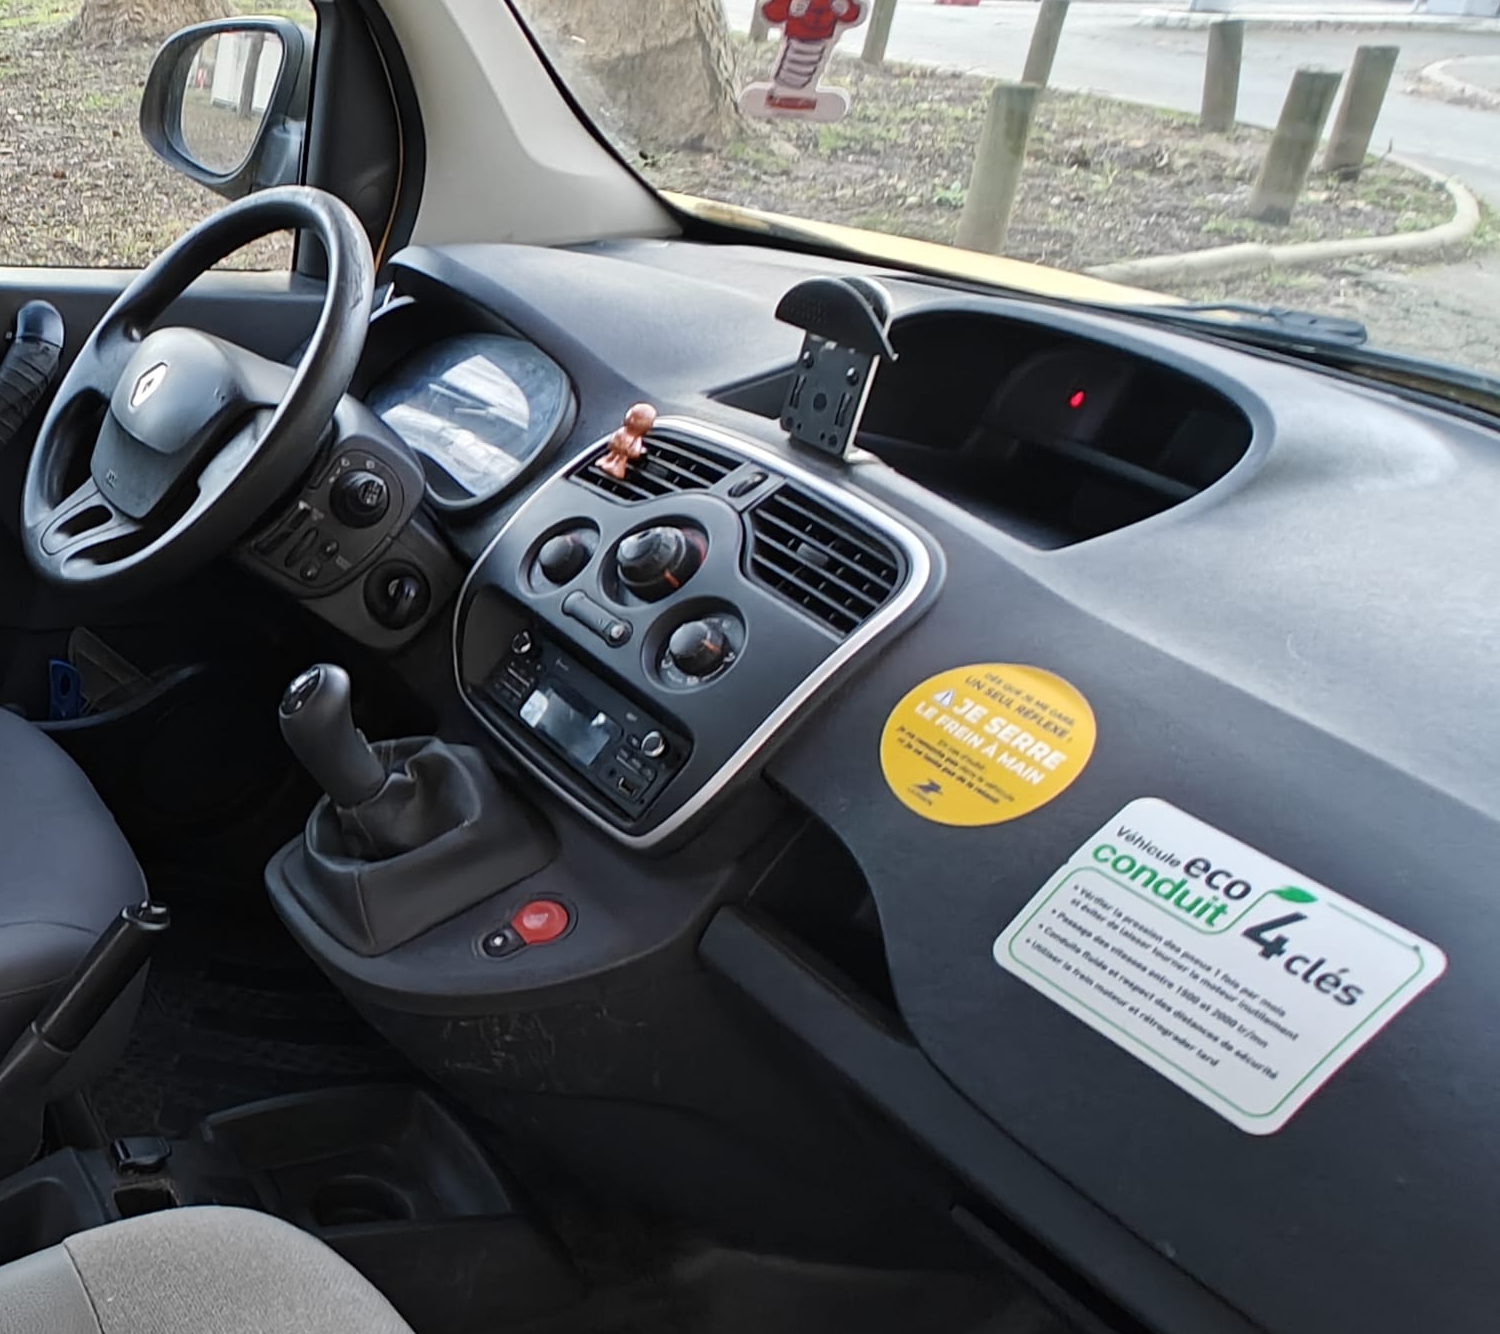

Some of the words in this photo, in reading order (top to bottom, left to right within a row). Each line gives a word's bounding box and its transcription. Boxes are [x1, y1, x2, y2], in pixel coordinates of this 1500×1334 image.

[914, 701, 938, 720] LE
[935, 714, 984, 748] FREIN
[980, 740, 998, 758] À
[996, 751, 1045, 785] MAIN
[952, 697, 989, 724] JE
[983, 716, 1066, 770] SERRE
[964, 674, 985, 691] UN
[983, 687, 1014, 709] SEUL
[1013, 704, 1070, 738] RÉFLEXE
[1034, 699, 1049, 711] ME
[1092, 844, 1228, 927] conduit
[1116, 825, 1181, 868] Véhicule
[1183, 857, 1251, 900] eco
[1056, 911, 1093, 938] Passage
[1092, 935, 1110, 949] des
[1109, 946, 1148, 973] vitesses
[1147, 969, 1175, 989] entre
[1175, 985, 1201, 1005] 1500
[1210, 1008, 1238, 1028] 2000
[1079, 887, 1113, 911] Vérifier
[1112, 907, 1123, 918] la
[1121, 915, 1163, 943] pression
[1162, 939, 1182, 954] des
[1179, 950, 1213, 972] pneus
[1220, 973, 1240, 989] fois
[1238, 987, 1259, 1000] par
[1259, 998, 1286, 1018] mois
[1080, 904, 1106, 922] éviter
[1118, 926, 1152, 949] laisser
[1151, 946, 1189, 973] tourner
[1199, 977, 1238, 1003] moteur
[1237, 1000, 1299, 1041] inutilement
[1241, 912, 1308, 959] 4
[1284, 955, 1364, 1007] clés
[1030, 940, 1063, 964] Utiliser
[1071, 967, 1094, 986] frein
[1093, 982, 1128, 1007] moteur
[1138, 1012, 1195, 1051] rétrograder
[1195, 1048, 1220, 1067] tard
[1043, 926, 1082, 954] Conduite
[1081, 950, 1108, 971] fluide
[1118, 974, 1155, 1001] respect
[1153, 998, 1173, 1013] des
[1172, 1010, 1219, 1043] distances
[1233, 1049, 1278, 1080] sécurité
